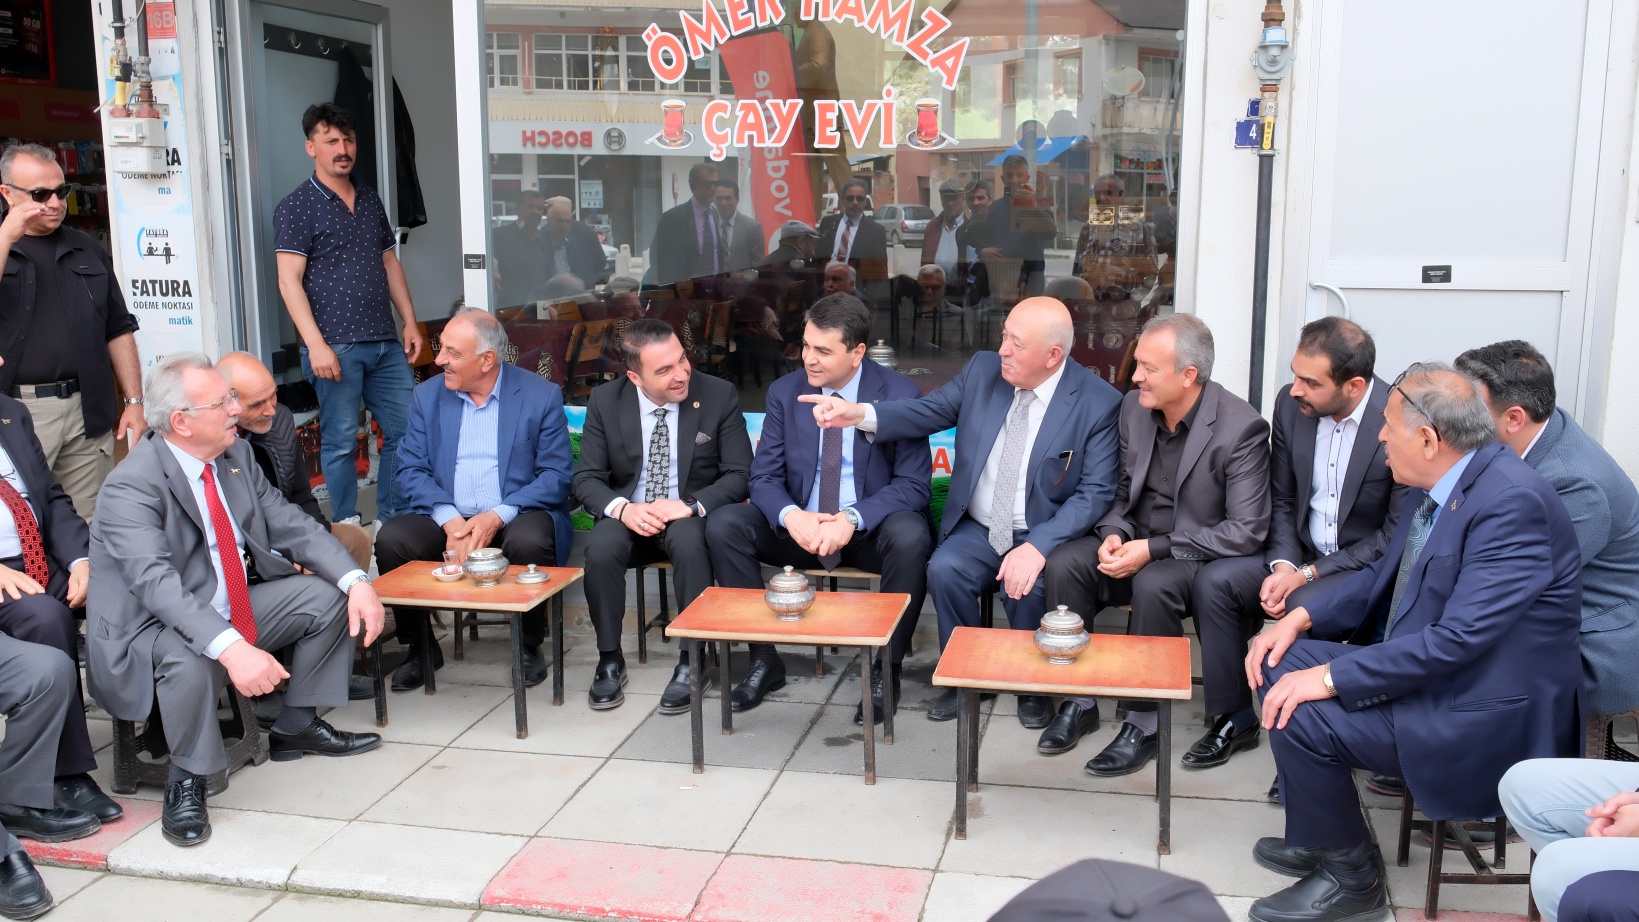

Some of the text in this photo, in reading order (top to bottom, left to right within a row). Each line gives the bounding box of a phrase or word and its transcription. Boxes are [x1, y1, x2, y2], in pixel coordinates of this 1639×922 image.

[146, 11, 175, 29] 16B
[642, 0, 786, 84] ÖMER
[702, 85, 897, 162] ÇAY EVİ
[131, 278, 193, 298] FATURA
[133, 299, 194, 310] ÖDEME NOKTASI
[168, 316, 193, 326] matik
